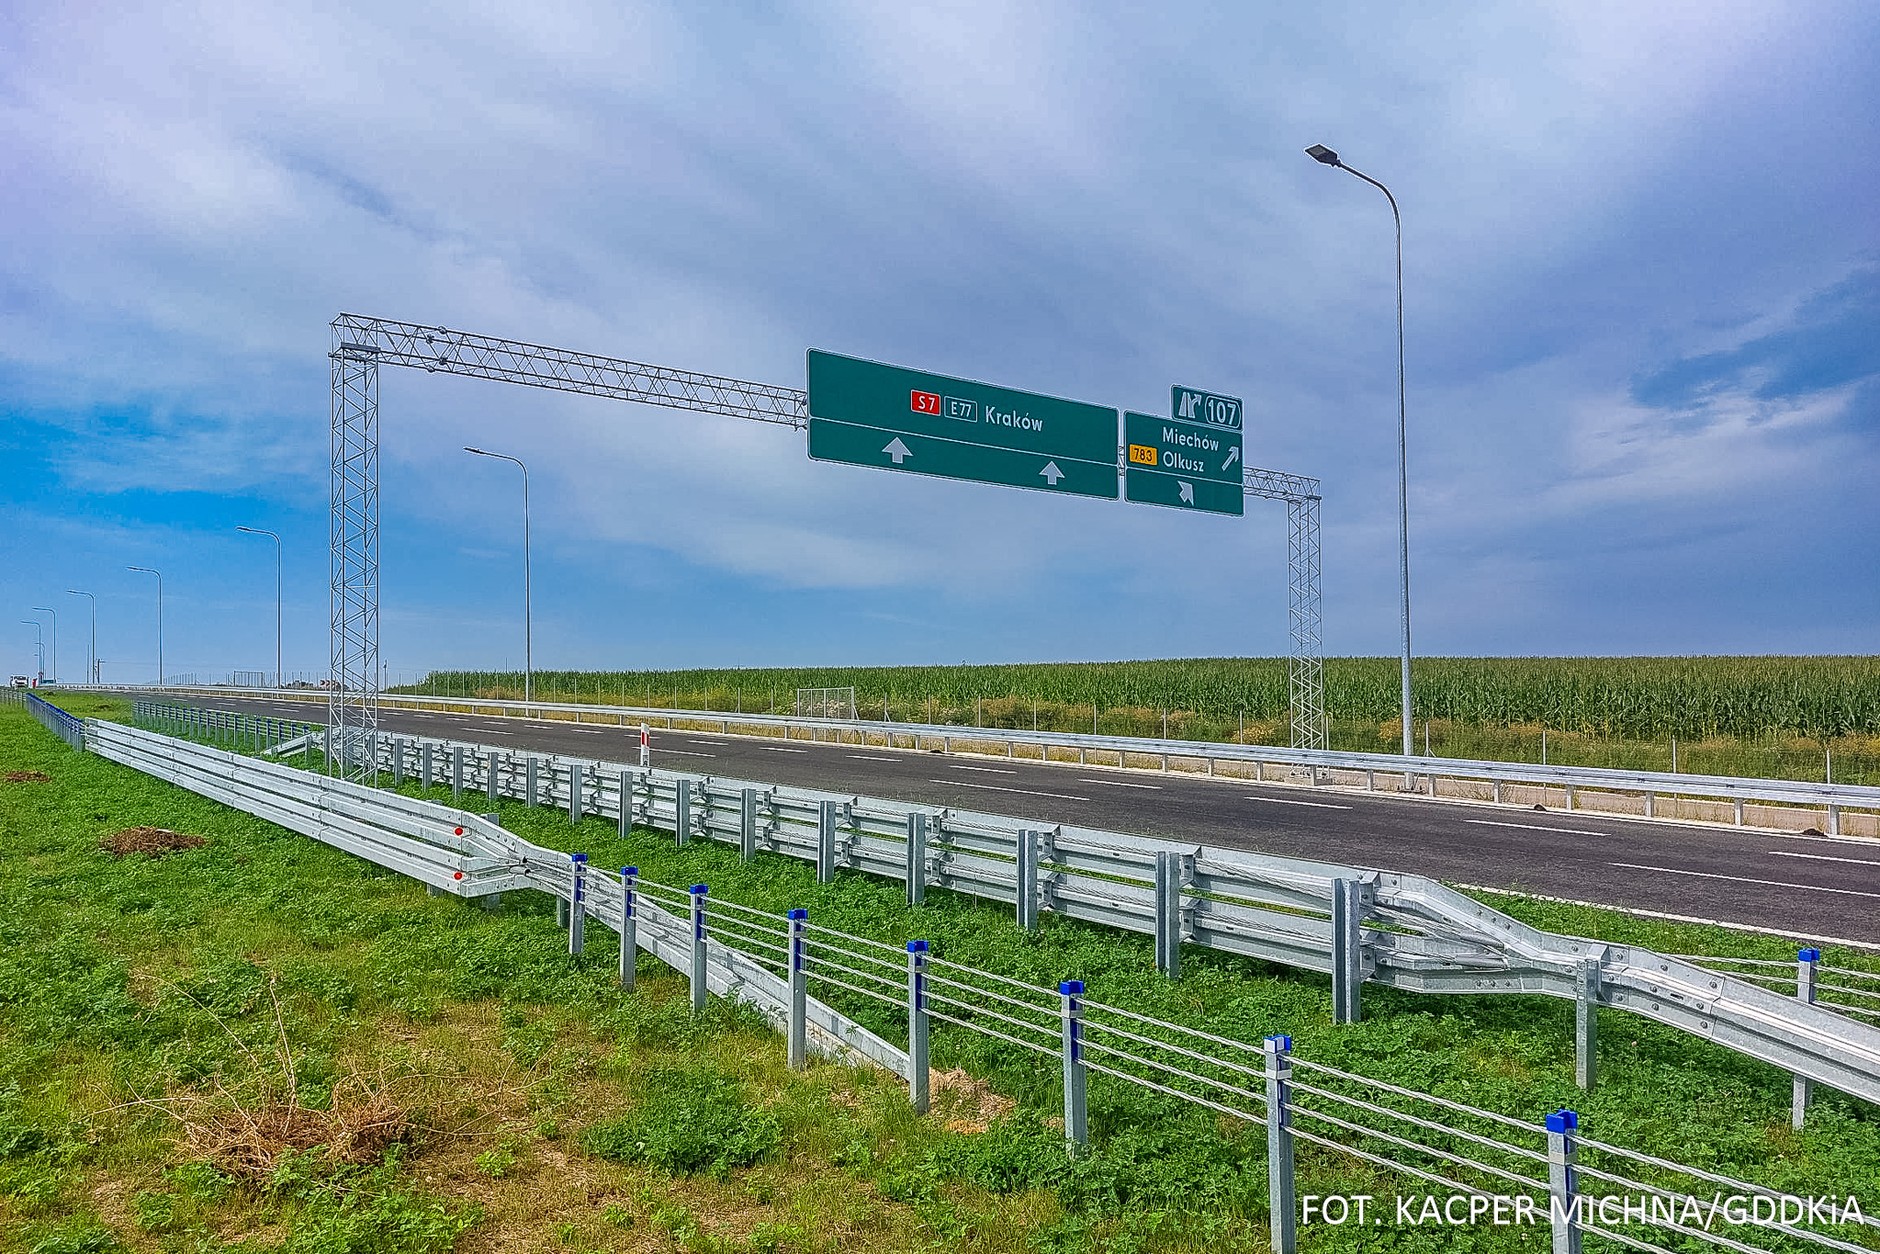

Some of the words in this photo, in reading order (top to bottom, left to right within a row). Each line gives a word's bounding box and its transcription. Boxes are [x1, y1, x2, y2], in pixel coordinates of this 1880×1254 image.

[918, 395, 935, 411] S7
[951, 401, 972, 418] E77
[985, 405, 1043, 432] Kraków
[1208, 399, 1236, 425] 107
[1163, 427, 1219, 451] Miechów
[1133, 448, 1153, 462] 783
[1163, 451, 1204, 472] Olkusz
